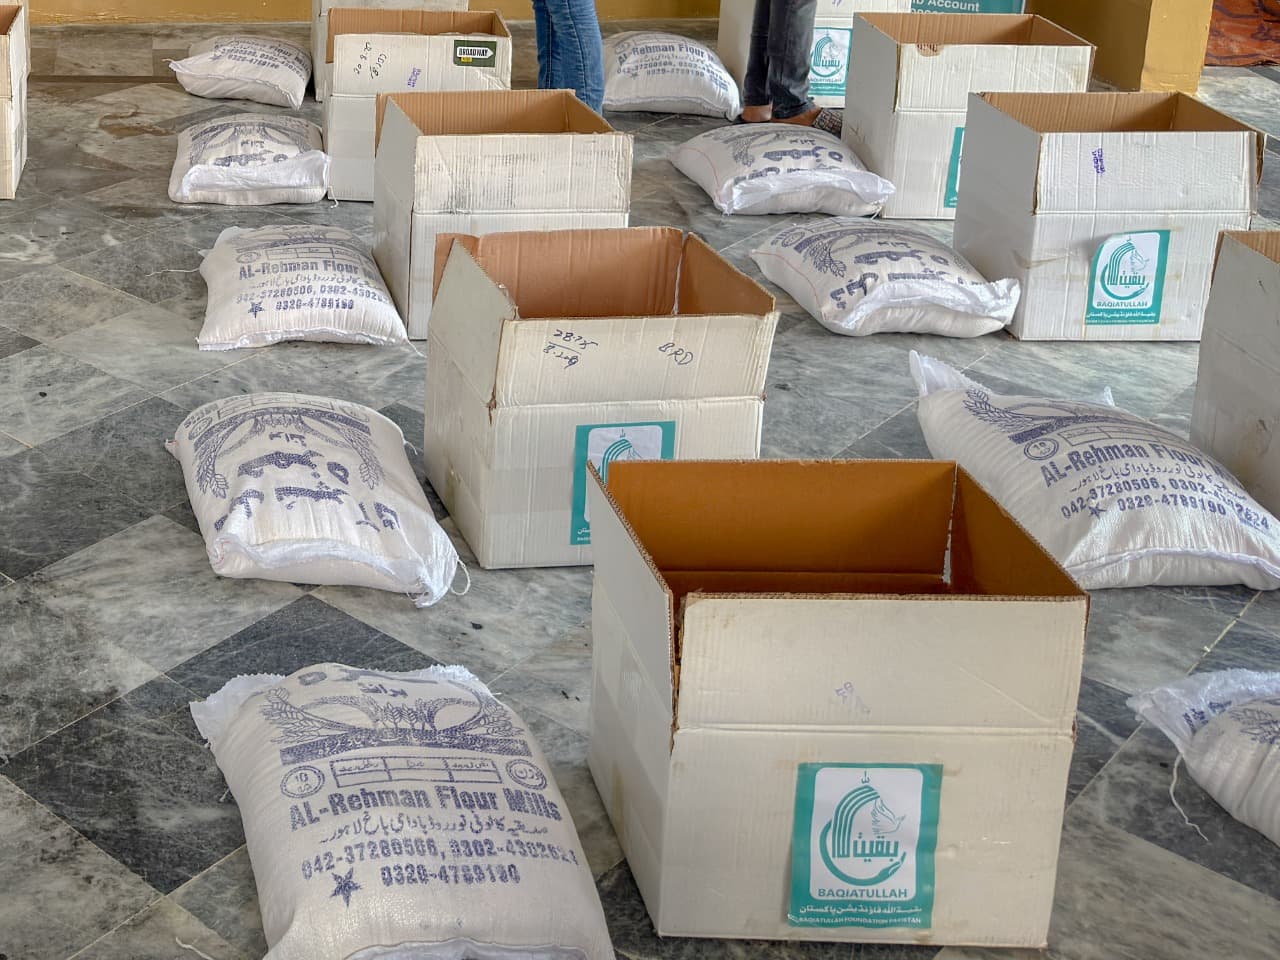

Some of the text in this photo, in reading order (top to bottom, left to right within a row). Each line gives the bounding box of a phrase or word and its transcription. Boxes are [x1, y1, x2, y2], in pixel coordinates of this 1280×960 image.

[458, 47, 489, 57] BROADWAY
[679, 44, 705, 58] Flour
[323, 259, 359, 275] Flour
[1040, 441, 1205, 488] AL-Rehman Flour
[289, 785, 563, 831] AL-Rehman Flour Mills
[818, 888, 908, 898] BAQIATULLAH
